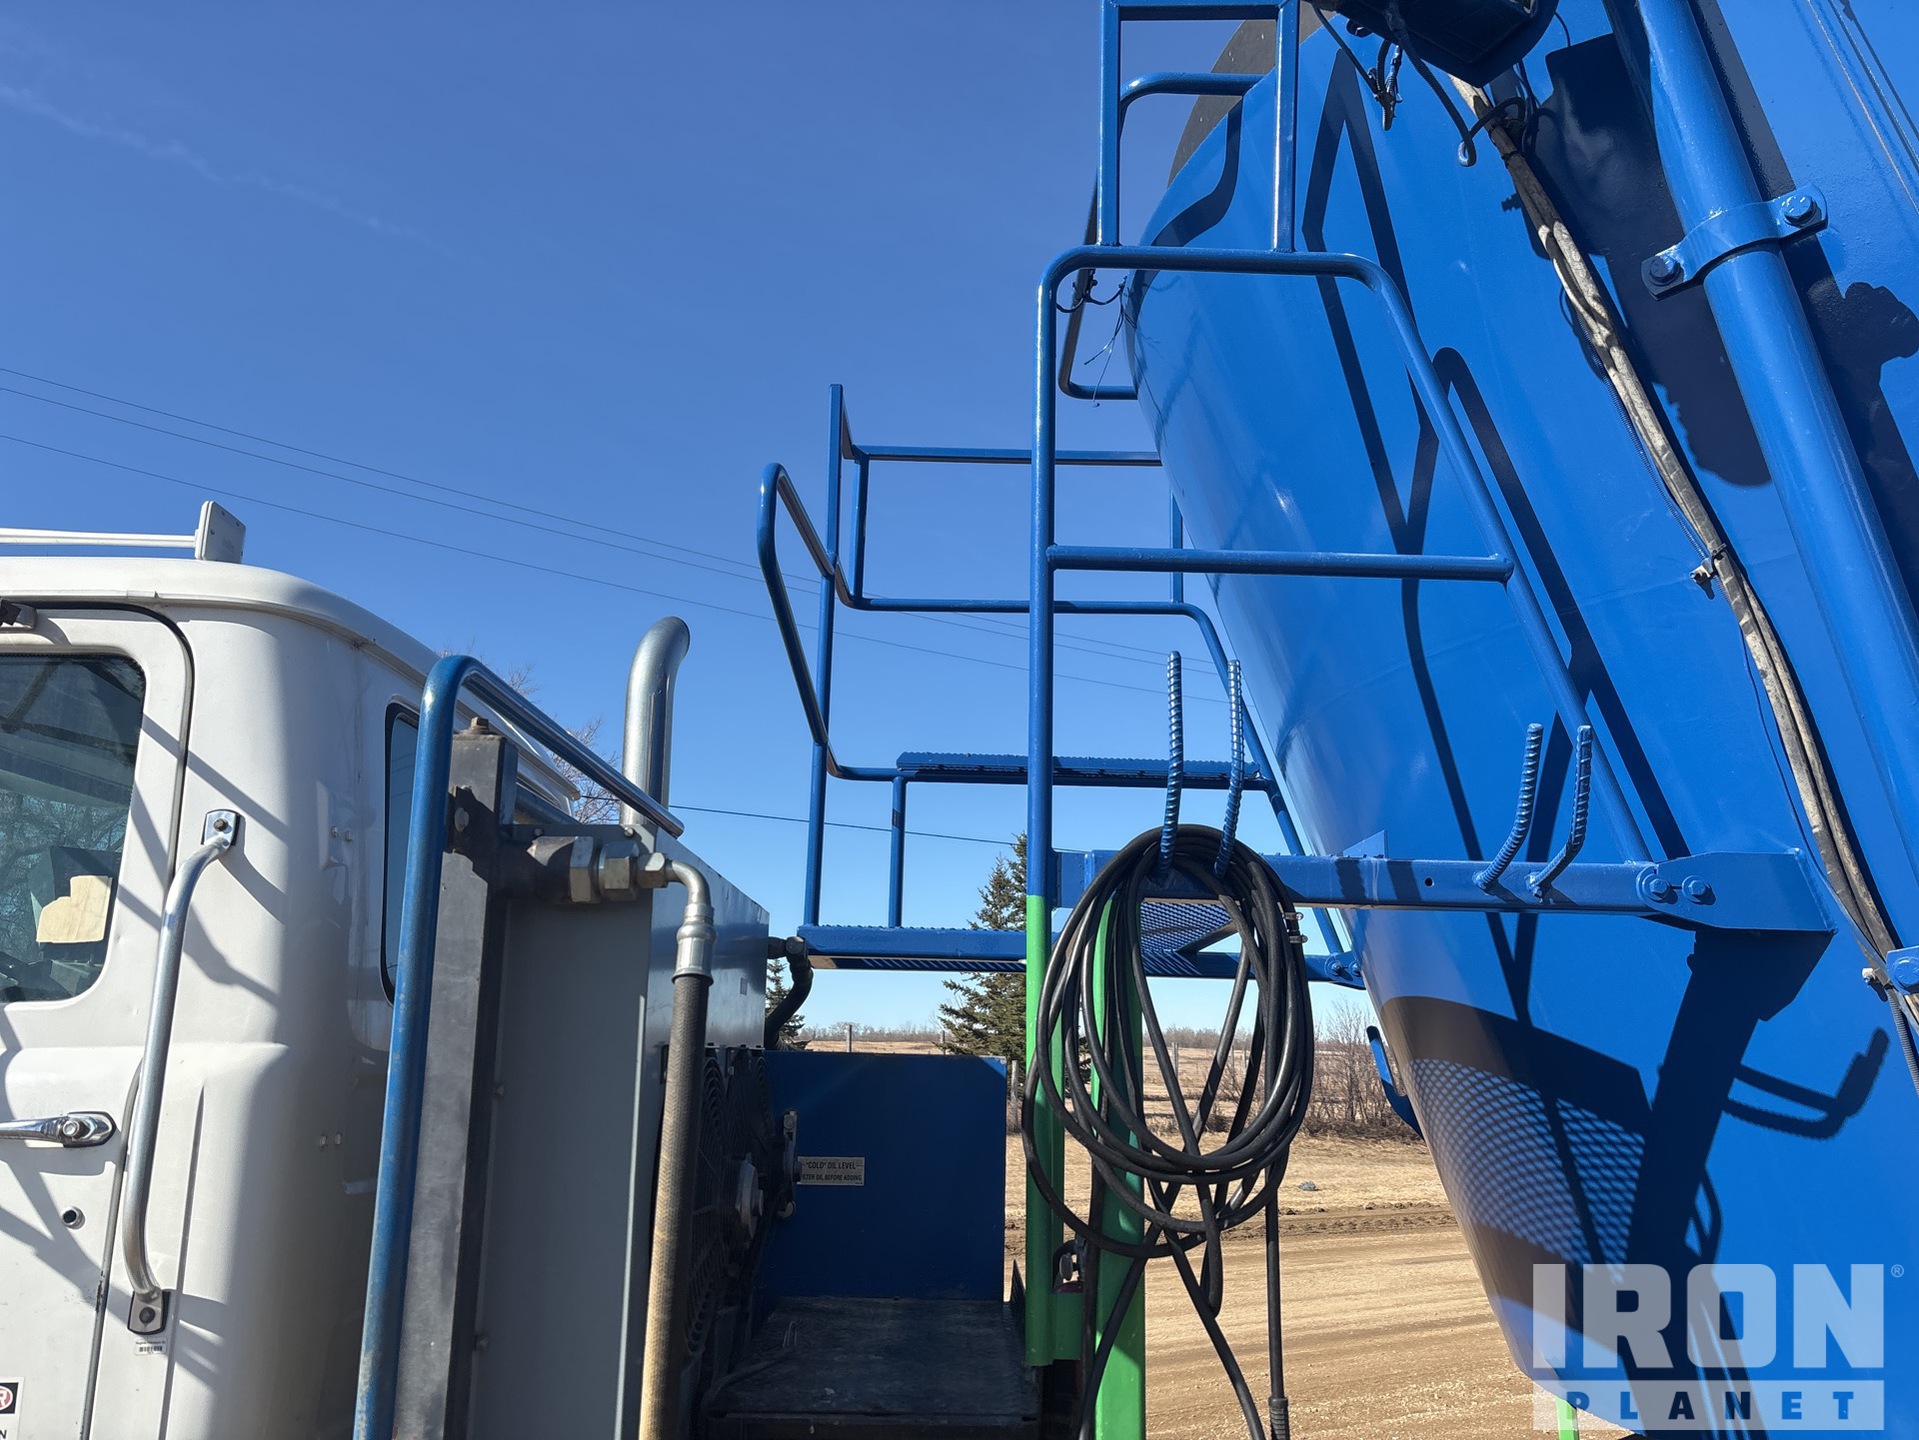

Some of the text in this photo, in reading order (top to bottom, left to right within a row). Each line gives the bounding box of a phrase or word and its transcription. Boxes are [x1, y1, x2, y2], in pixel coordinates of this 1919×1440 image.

[806, 1161, 855, 1169] "COLD" OIL LEVEL
